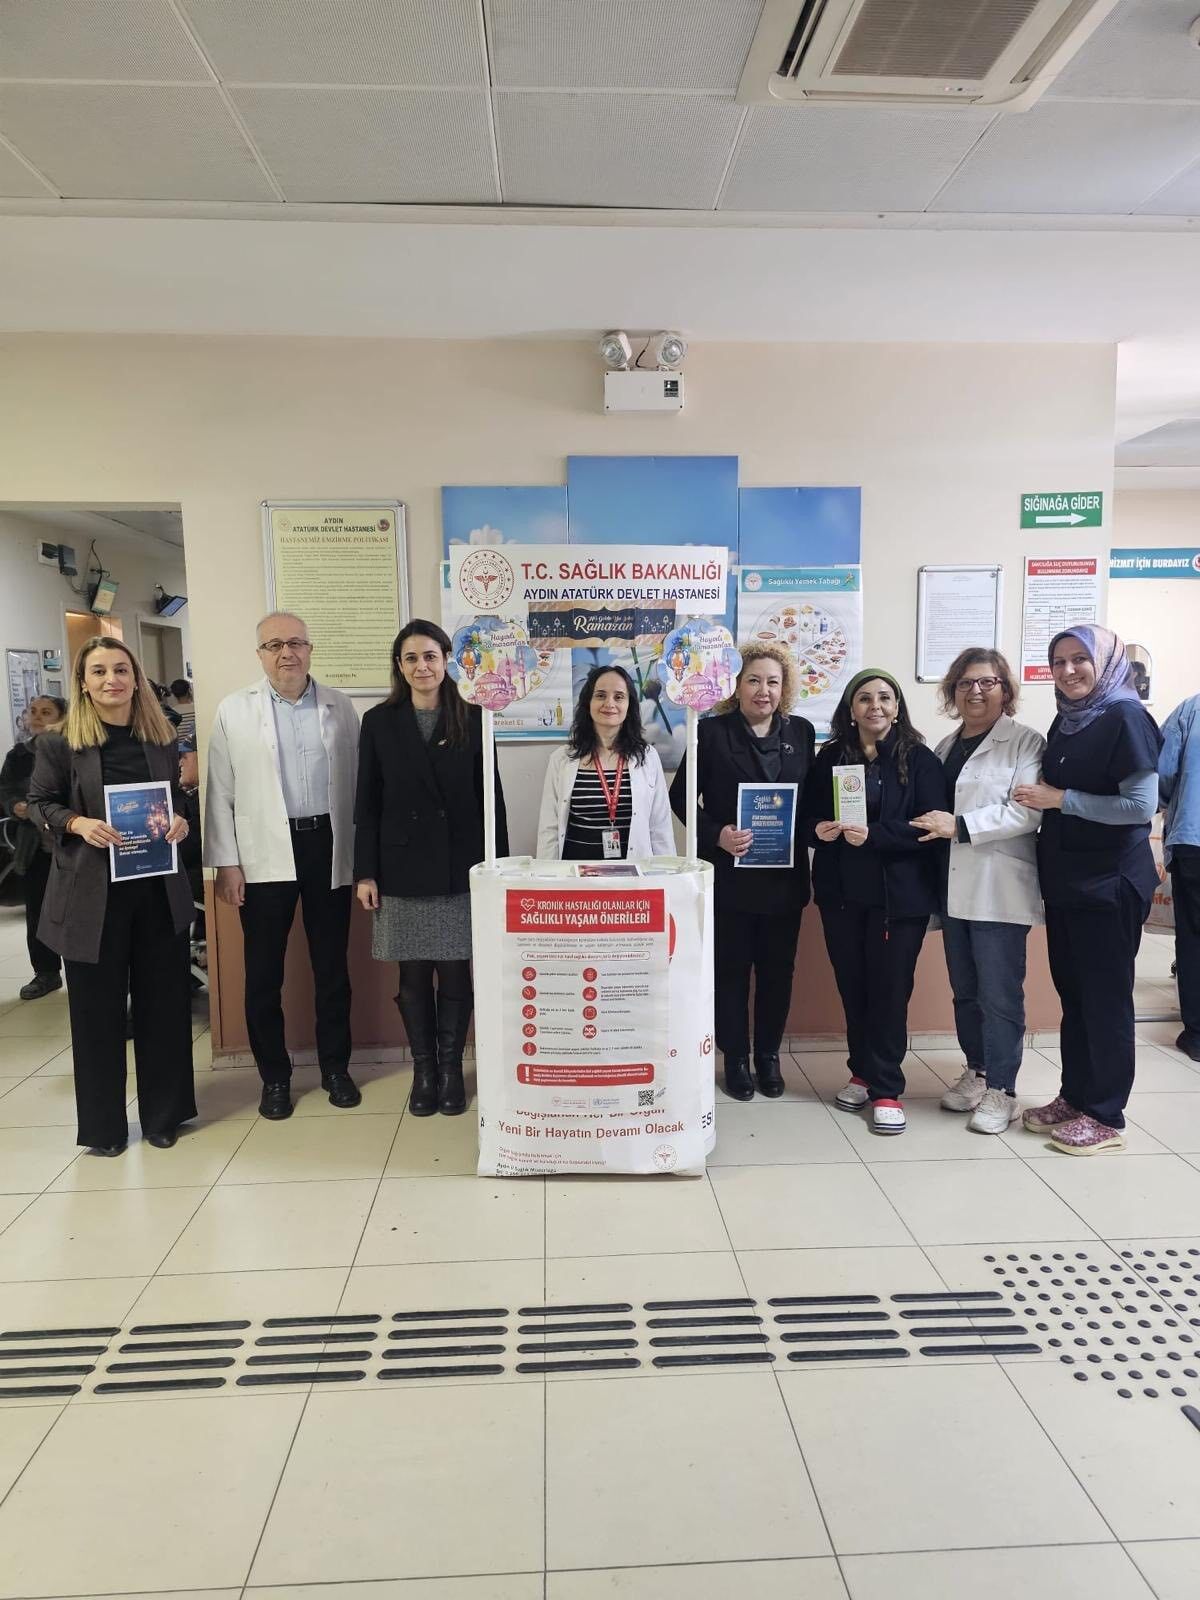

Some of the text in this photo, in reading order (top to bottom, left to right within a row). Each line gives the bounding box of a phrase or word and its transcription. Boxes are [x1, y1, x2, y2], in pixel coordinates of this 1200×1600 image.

[1024, 494, 1100, 511] SIĞINAĞA GİDER
[321, 525, 342, 533] DEVLET
[344, 525, 376, 533] HASTANESİ
[521, 563, 552, 580] T.C.
[559, 559, 626, 580] SAĞLIK
[632, 560, 721, 580] BAKANLIĞI
[1136, 556, 1151, 570] İÇİN
[1152, 558, 1190, 568] BURDAYIZ
[795, 577, 818, 585] Yemek
[819, 577, 841, 586] Tabağı
[523, 586, 720, 600] AYDIN ATATÜRK DEVLET HASTANESİ
[573, 615, 633, 634] Ramazan
[537, 899, 650, 911] KRONİK HASTALIĞI OLANLAR İÇİN
[521, 911, 650, 927] SAĞLIKLI YAŞAM ÖNERİLERİ
[498, 1120, 521, 1135] Yeni
[525, 1126, 541, 1137] Bir
[546, 1127, 592, 1140] Hayatın
[596, 1126, 641, 1138] Devamı
[645, 1120, 684, 1134] Olacak
